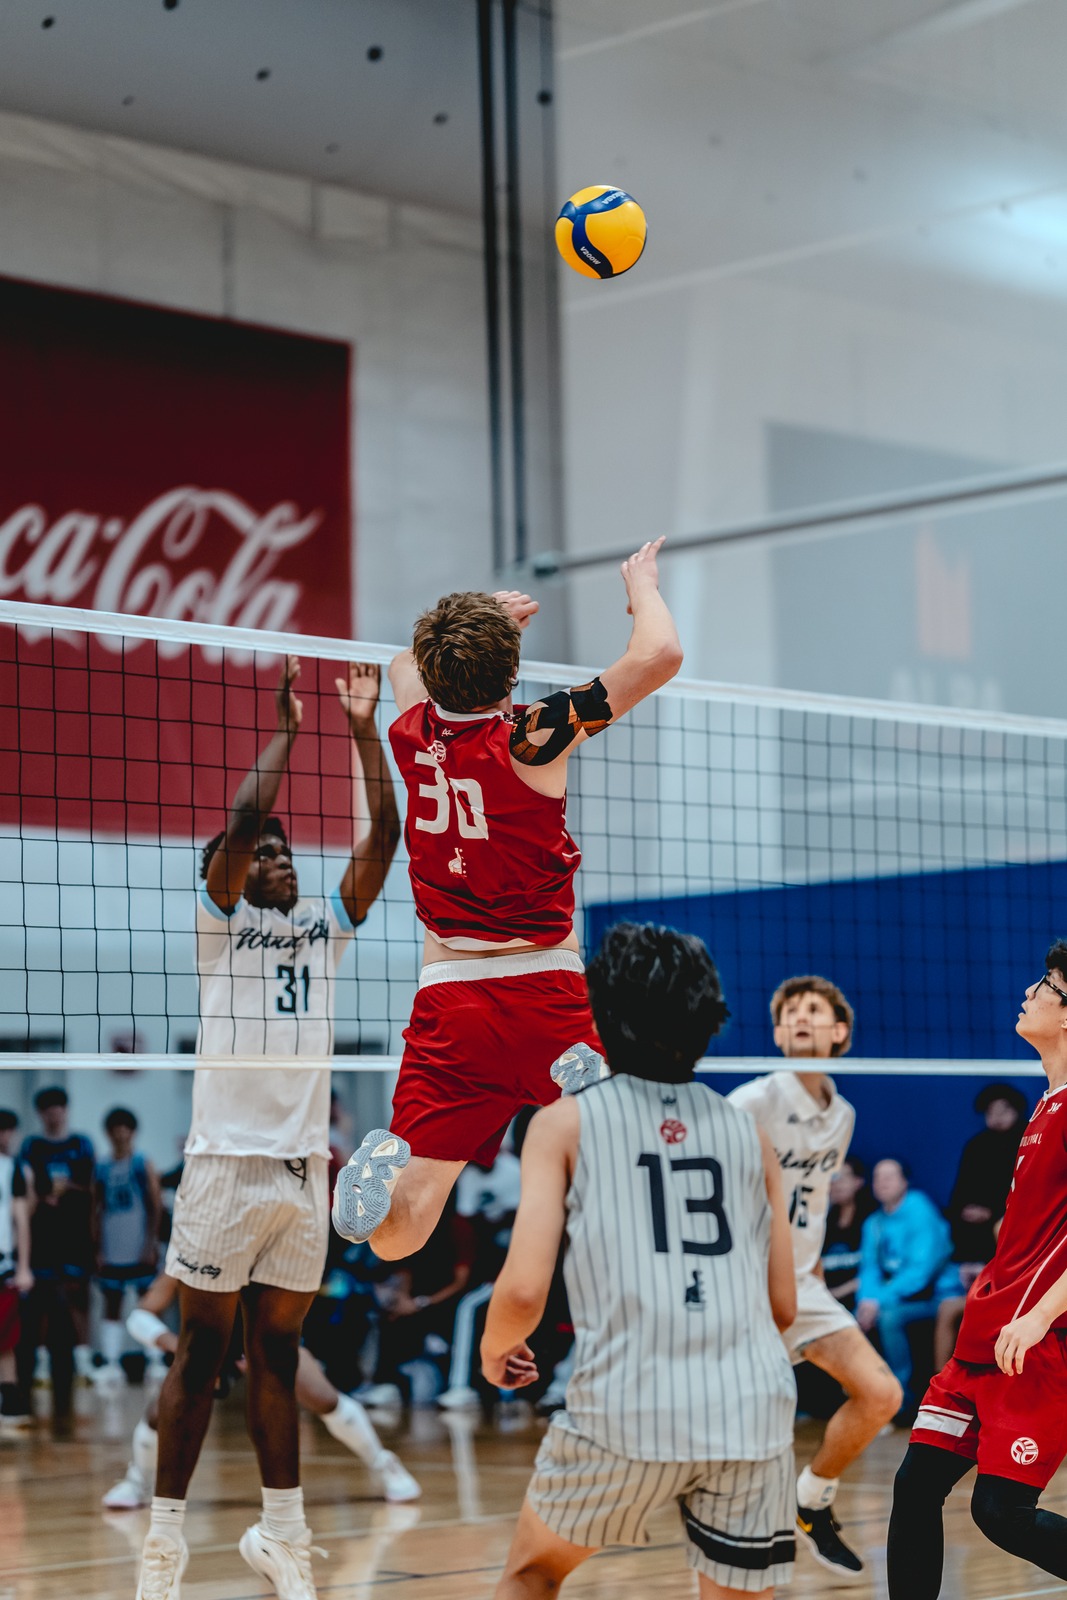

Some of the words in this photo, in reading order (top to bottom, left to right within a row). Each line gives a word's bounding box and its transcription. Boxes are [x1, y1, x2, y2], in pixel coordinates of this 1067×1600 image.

[580, 246, 601, 264] V200W
[414, 750, 490, 841] 30
[276, 964, 310, 1013] 31
[637, 1153, 733, 1256] 13
